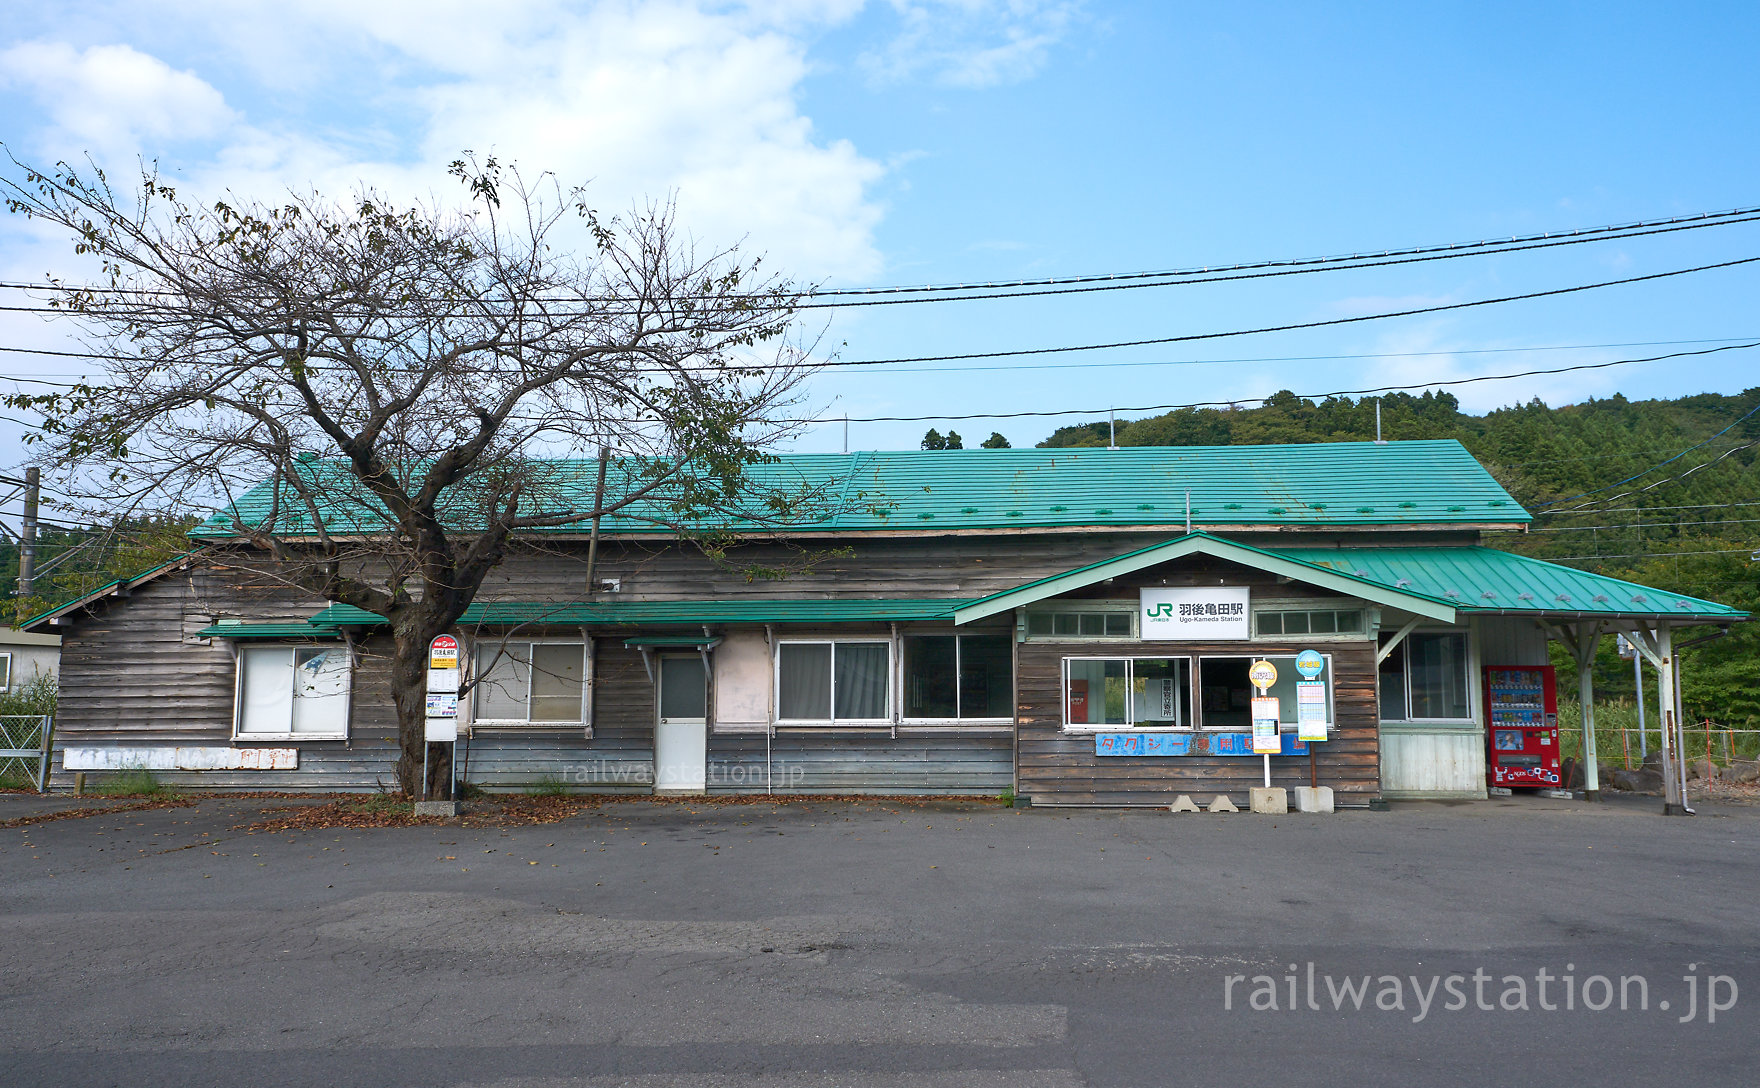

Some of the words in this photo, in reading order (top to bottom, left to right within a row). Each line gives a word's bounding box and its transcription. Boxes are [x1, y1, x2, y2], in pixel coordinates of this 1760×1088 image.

[1147, 603, 1173, 617] JR
[1179, 603, 1243, 616] 羽後亀田駅
[1102, 737, 1306, 751] タクシー専用駐場
